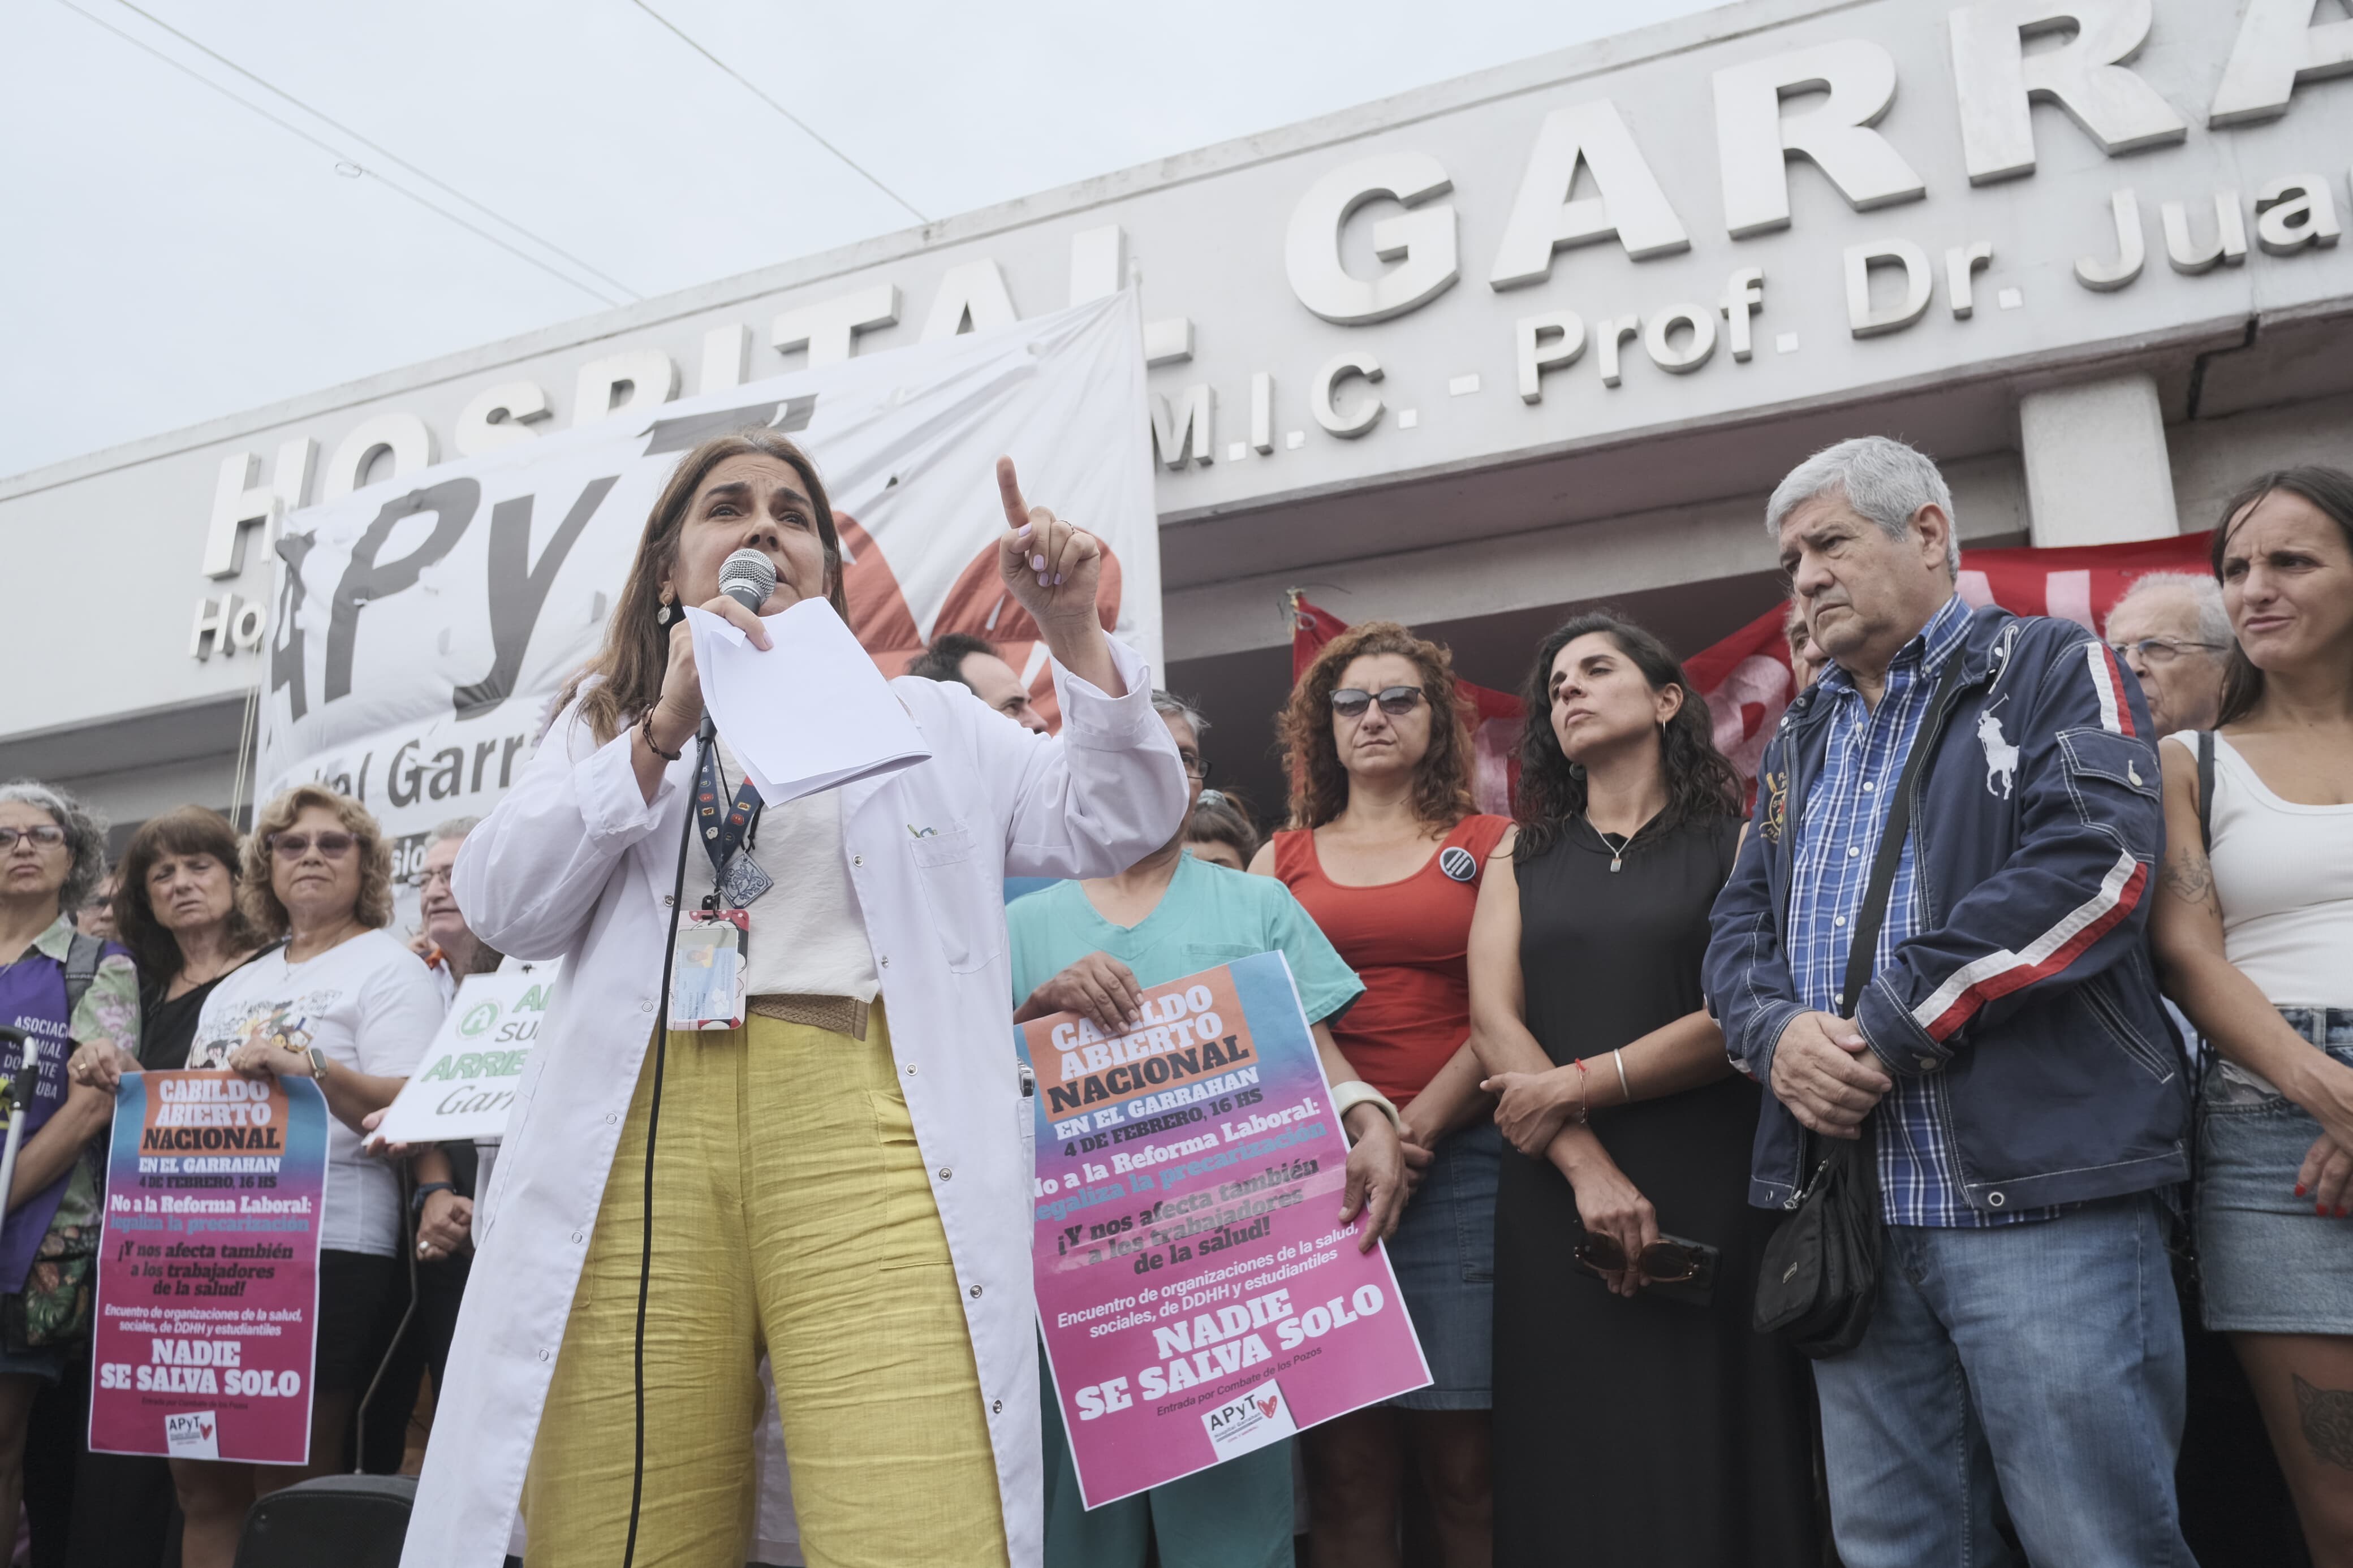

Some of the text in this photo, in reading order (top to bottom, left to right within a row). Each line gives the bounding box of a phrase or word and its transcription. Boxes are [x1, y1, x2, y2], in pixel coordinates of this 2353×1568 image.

[1516, 267, 1799, 405] Prof.
[1842, 238, 2023, 338] Dr.
[2074, 161, 2353, 292] Jua
[387, 733, 526, 808] Garr
[1051, 985, 1213, 1051] CALDO
[420, 1048, 530, 1082] ARRIE
[1061, 1012, 1223, 1081] ABIERTO
[36, 1081, 57, 1099] UBA
[160, 1079, 270, 1102] CABILDO
[1046, 1035, 1250, 1113] NACIONAL
[155, 1103, 272, 1127] ABIERTO
[1054, 1066, 1260, 1141] EN EL GARRAHAN
[1064, 1087, 1264, 1157] 4 DE FEBRERO, 16 HS
[143, 1128, 281, 1150] NACIONAL
[1063, 1172, 1081, 1189] a
[1081, 1163, 1110, 1183] la
[1111, 1132, 1220, 1175] Reforma
[1220, 1097, 1321, 1143] Laboral:
[139, 1157, 281, 1173] EN EL GARRAHAN
[139, 1176, 277, 1190] 4 DE FEBRERO, 16 HS
[1035, 1121, 1328, 1222] egaliza la precarización
[111, 1194, 312, 1214] No a la Reforma Laboral:
[1089, 1215, 1133, 1241] nos
[1139, 1191, 1214, 1226] afecta
[1219, 1158, 1320, 1202] también
[167, 1215, 183, 1231] la
[187, 1214, 309, 1236] precarización
[1088, 1188, 1304, 1265] a los trabajadores
[137, 1245, 161, 1257] nos
[165, 1241, 216, 1258] afecta
[221, 1242, 294, 1259] también
[1134, 1216, 1270, 1275] de la salud!
[131, 1261, 275, 1282] a los trabajadores
[153, 1280, 247, 1297] de la salud!
[1058, 1222, 1359, 1328] Encuentro de organizaciones de la salud,
[1089, 1249, 1338, 1338] sociales, de DDHH y estudiantiles
[105, 1303, 303, 1323] Encuentro de organizaciones de la salud,
[160, 1320, 173, 1333] de
[174, 1321, 206, 1334] DDHH
[205, 1325, 214, 1338] y
[215, 1323, 282, 1336] estudiantiles
[1152, 1288, 1294, 1360] NADIE
[152, 1338, 241, 1368] NADIE
[1074, 1284, 1385, 1420] SE SALVA SOLO
[100, 1362, 301, 1398] SE SALVA SOLO
[1157, 1346, 1322, 1416] Entrada por Combate de los Pozos
[169, 1416, 201, 1433] APyT
[1210, 1394, 1256, 1431] APyT
